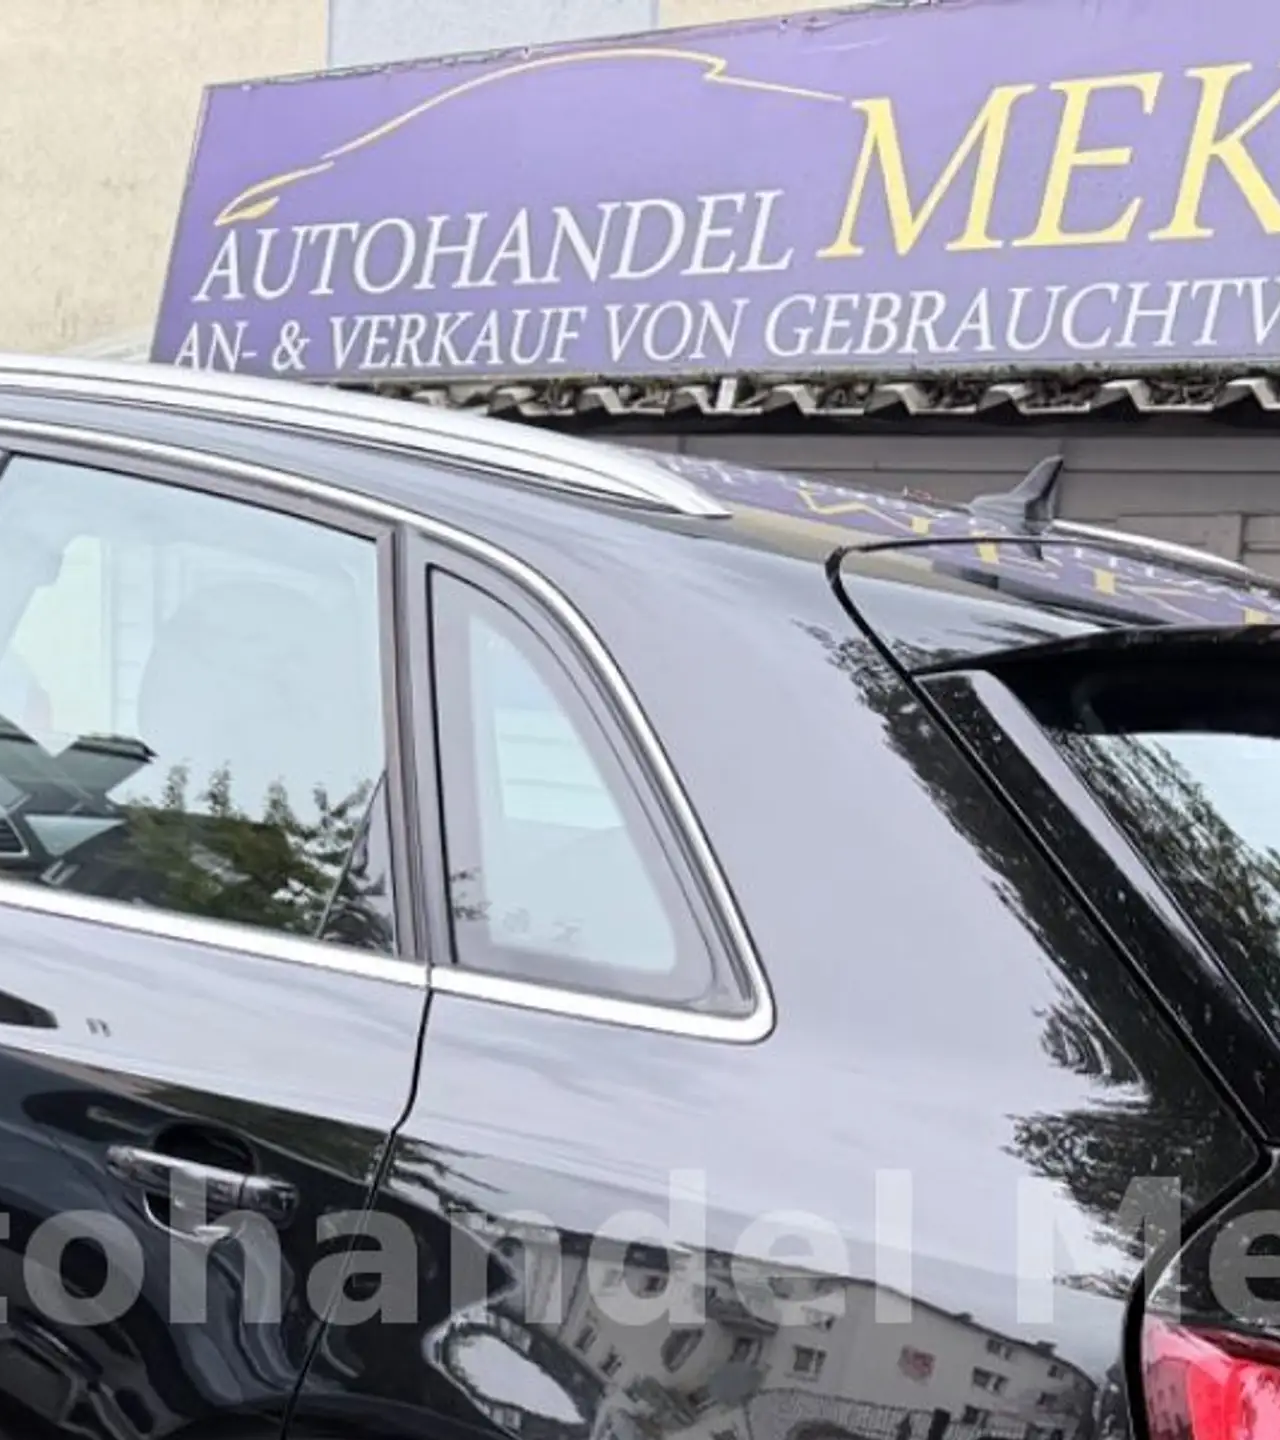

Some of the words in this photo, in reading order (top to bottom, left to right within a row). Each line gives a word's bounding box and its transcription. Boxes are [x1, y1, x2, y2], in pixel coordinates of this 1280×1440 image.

[192, 190, 794, 303] AUTOHANDEL
[174, 320, 258, 371] AN-
[271, 319, 312, 371] &
[328, 305, 587, 370] VERKAUF
[603, 300, 751, 364] VON
